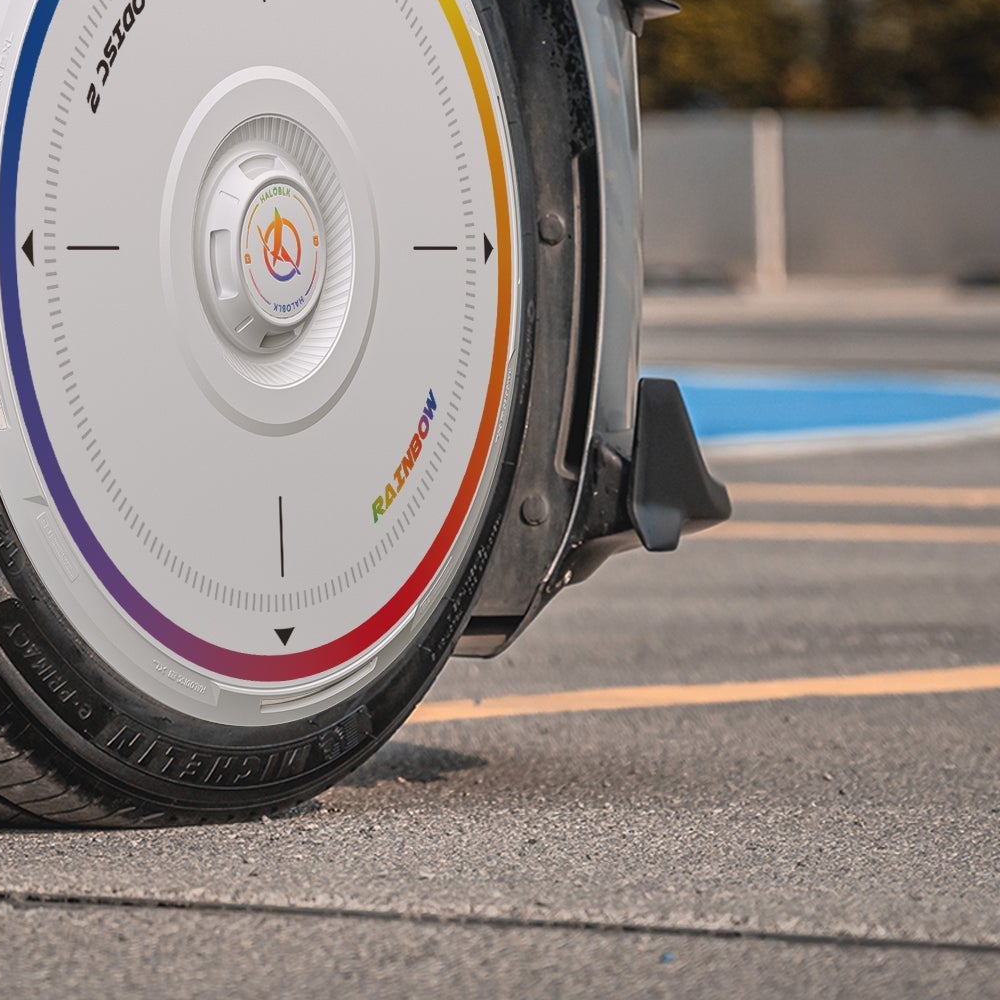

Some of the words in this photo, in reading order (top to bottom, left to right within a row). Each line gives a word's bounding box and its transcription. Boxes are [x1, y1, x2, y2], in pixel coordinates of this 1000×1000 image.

[86, 82, 101, 115] 2
[259, 185, 292, 204] HALOBLK
[272, 295, 306, 313] HALOBLK
[371, 387, 438, 525] RAINBOW
[106, 723, 312, 785] MICHELIN
